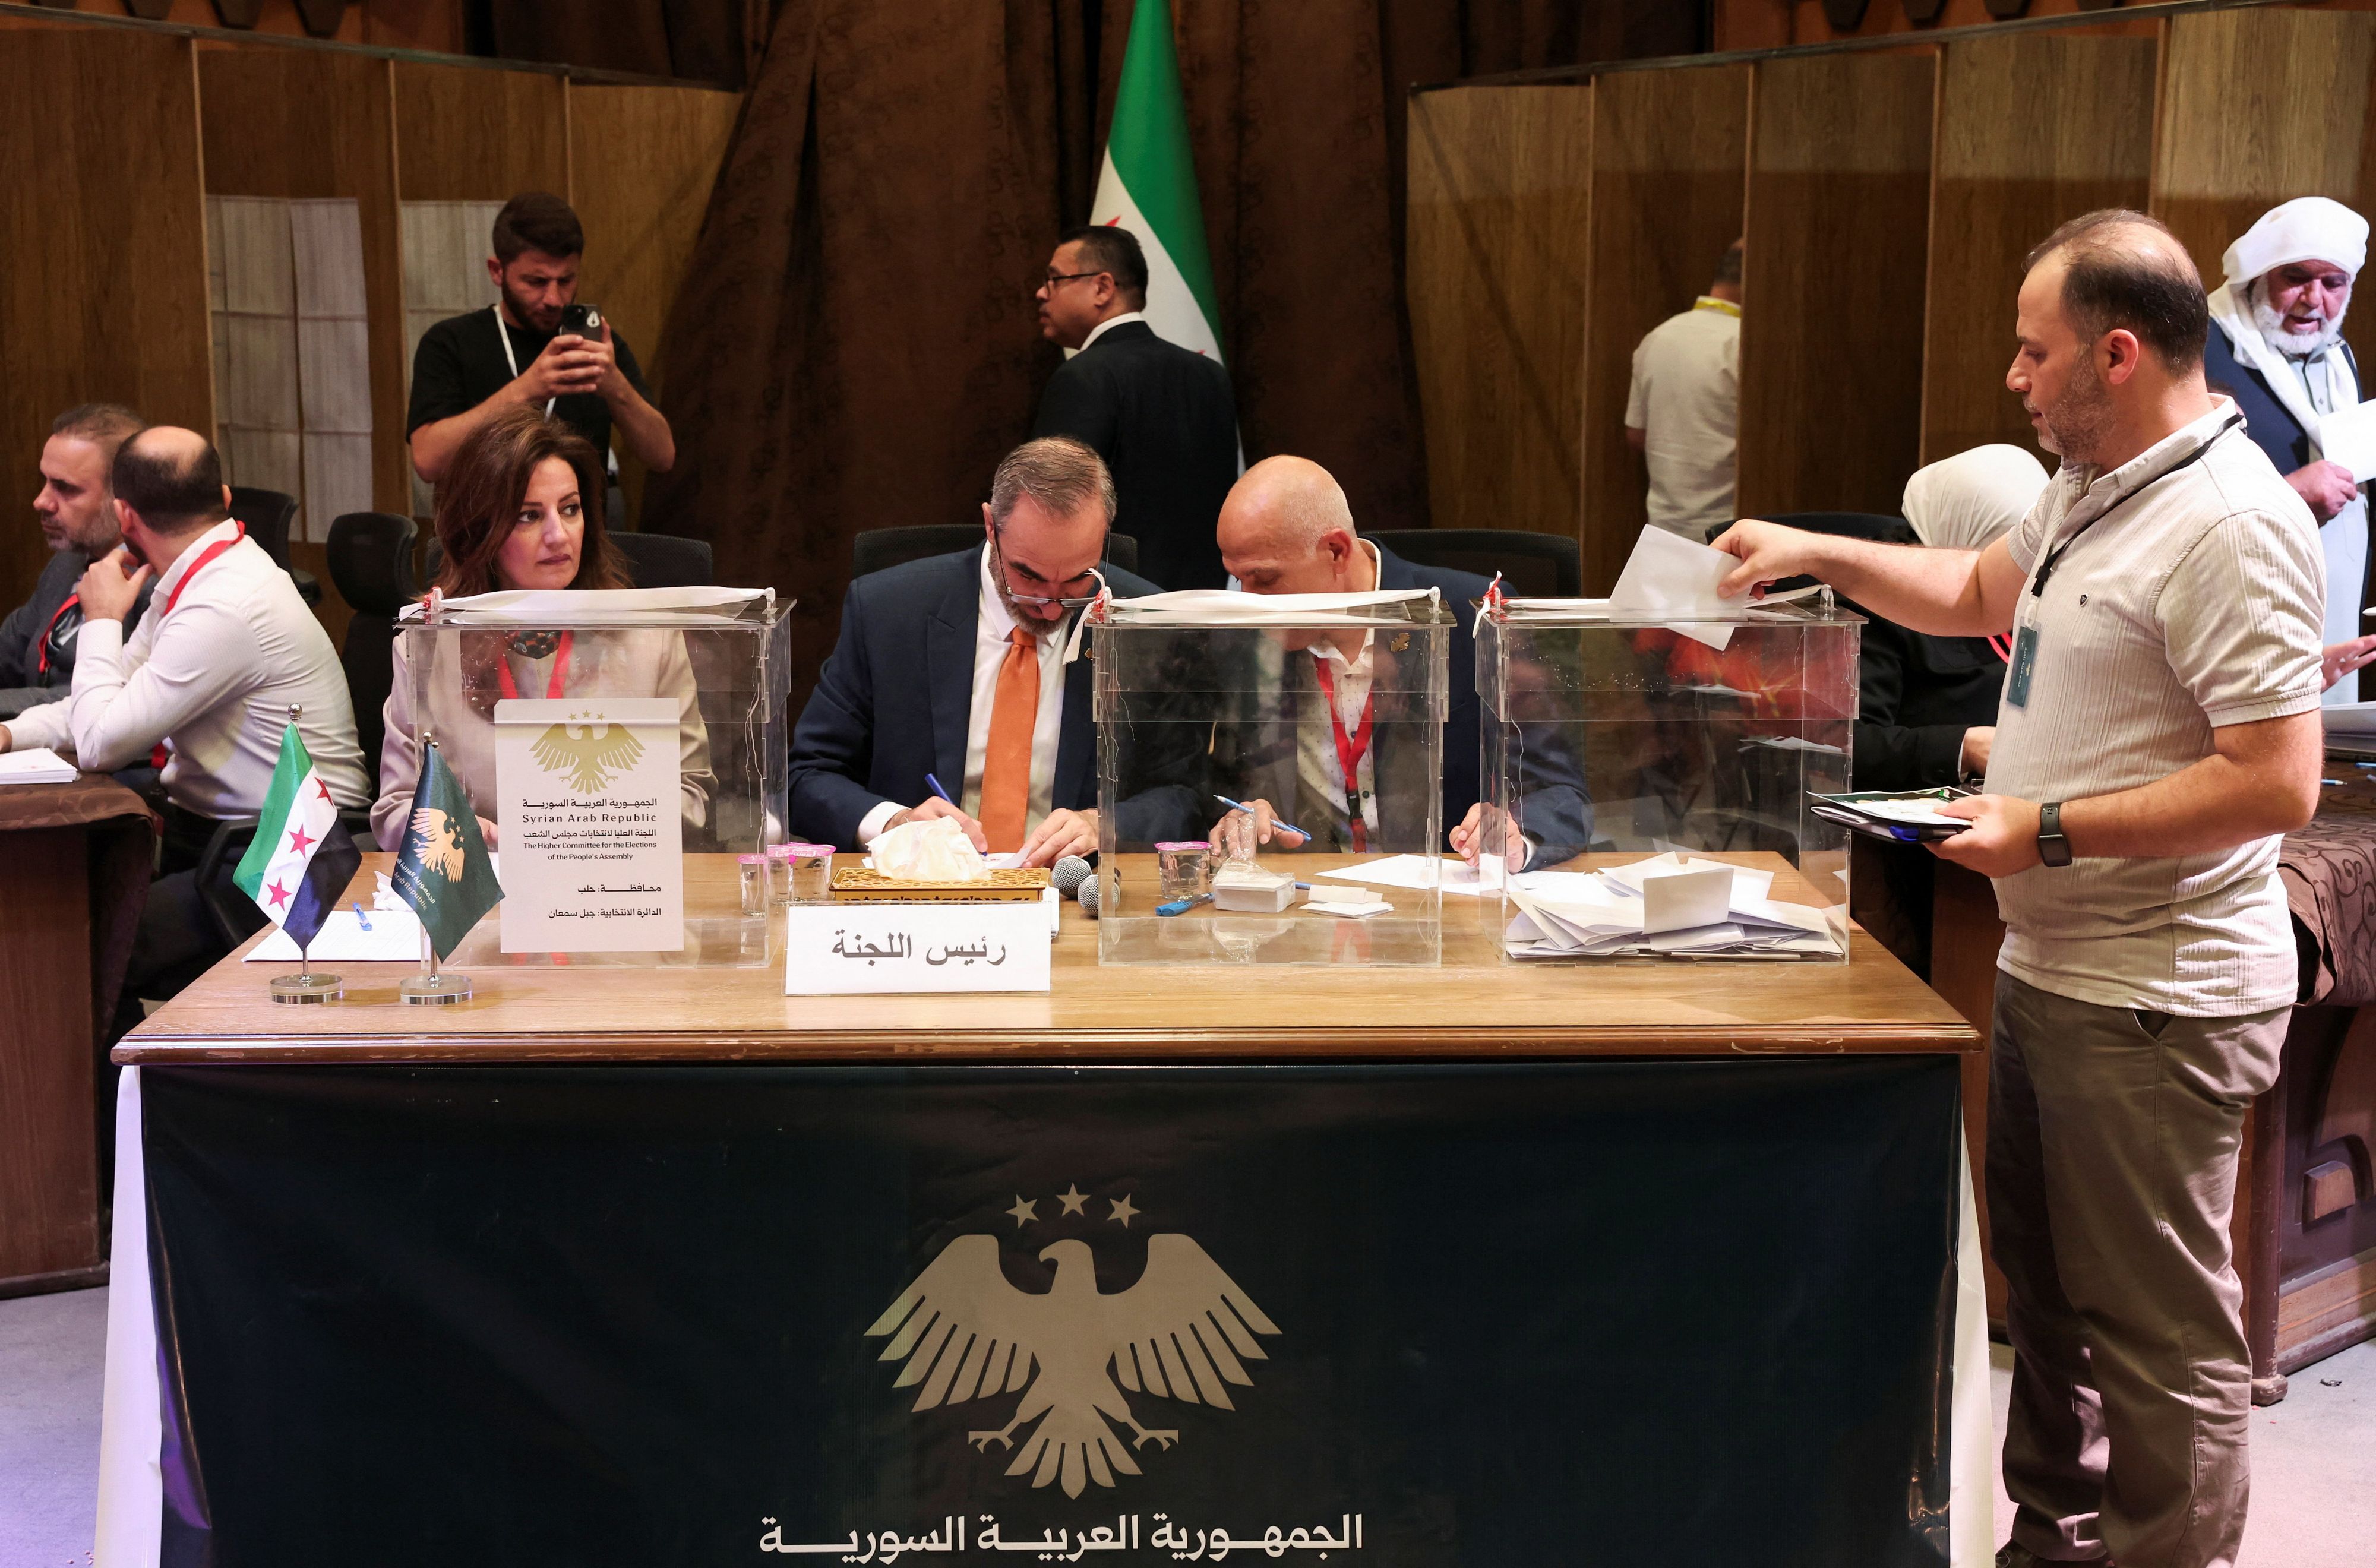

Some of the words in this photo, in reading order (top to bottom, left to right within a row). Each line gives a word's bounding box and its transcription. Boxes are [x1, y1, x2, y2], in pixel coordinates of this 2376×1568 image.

[522, 799, 568, 810] السورية
[570, 798, 607, 809] العربية
[609, 798, 657, 809] الجمهورية
[522, 814, 563, 824] Syrian
[568, 814, 596, 823] Arab
[602, 813, 656, 824] Republic
[523, 830, 550, 839] الشعب
[552, 830, 577, 839] مجلس
[579, 829, 612, 839] لانتخابات
[614, 829, 633, 839] العليا
[634, 829, 656, 839] اللجنة
[568, 853, 599, 862] People's
[394, 872, 405, 884] Arab
[404, 882, 427, 911] Republic
[414, 875, 436, 904] الجمهورية
[577, 884, 596, 894] حلب
[548, 909, 578, 919] سمعان
[579, 909, 596, 919] جبل
[598, 908, 635, 918] الانتخابية:
[637, 908, 661, 918] الدائرة
[831, 928, 912, 967] اللجنة
[925, 935, 1006, 966] رئيس
[760, 1515, 965, 1566] السورية
[977, 1514, 1139, 1563] العربية
[1151, 1512, 1363, 1562] الجمهورية
